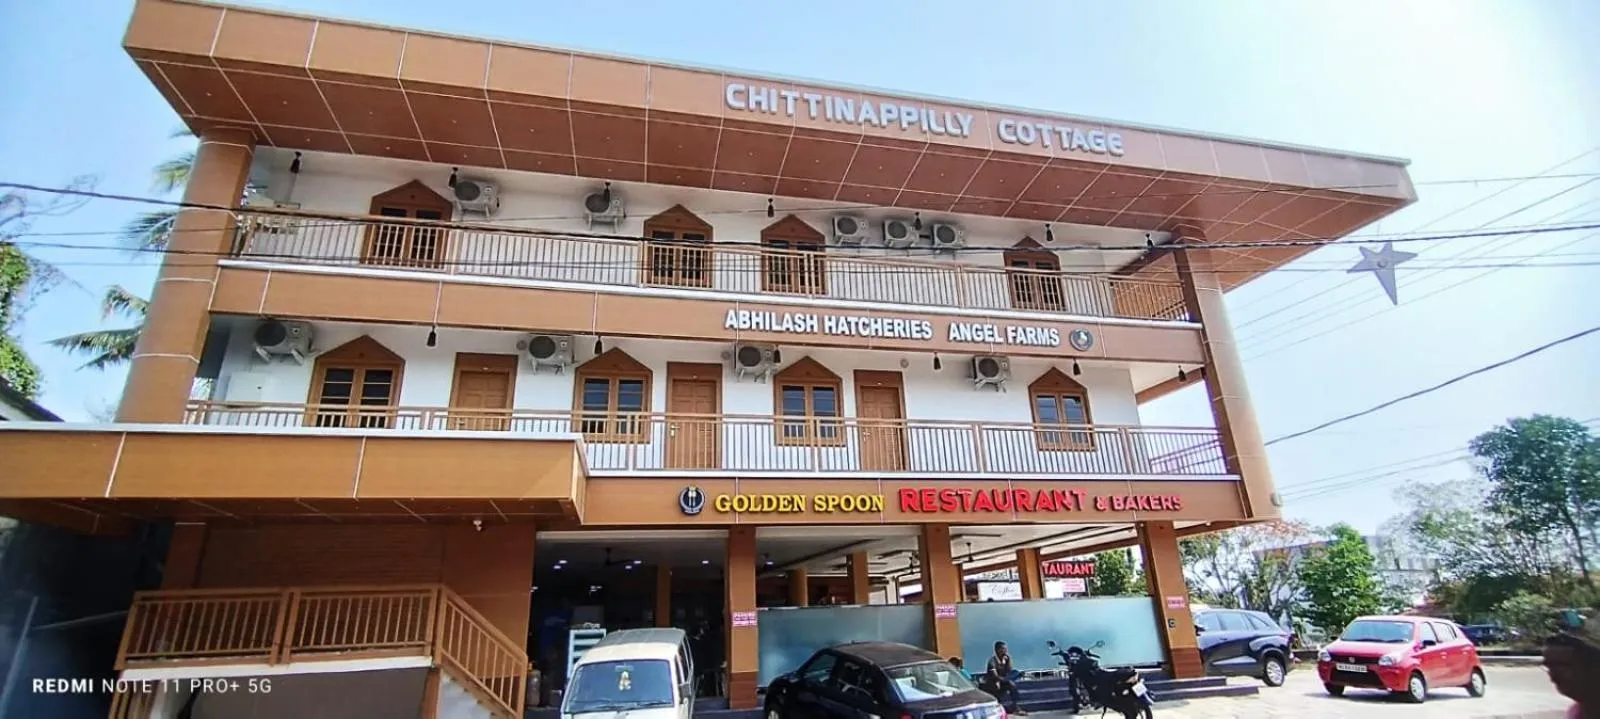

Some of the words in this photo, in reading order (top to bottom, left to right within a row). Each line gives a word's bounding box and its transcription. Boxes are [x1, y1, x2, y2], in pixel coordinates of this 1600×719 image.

[724, 83, 974, 137] CHITTINAPPILLY
[999, 118, 1125, 156] COTTAGE
[725, 309, 818, 334] ABHILASH
[824, 315, 932, 340] HATCHERIES
[948, 322, 1003, 344] ANGEL
[1006, 325, 1060, 347] FARMS
[715, 494, 806, 513] GOLDEN
[814, 494, 885, 513] SPOON
[899, 487, 1088, 513] RESTAURANT
[1095, 496, 1108, 512] &
[1112, 495, 1184, 512] BAKERS
